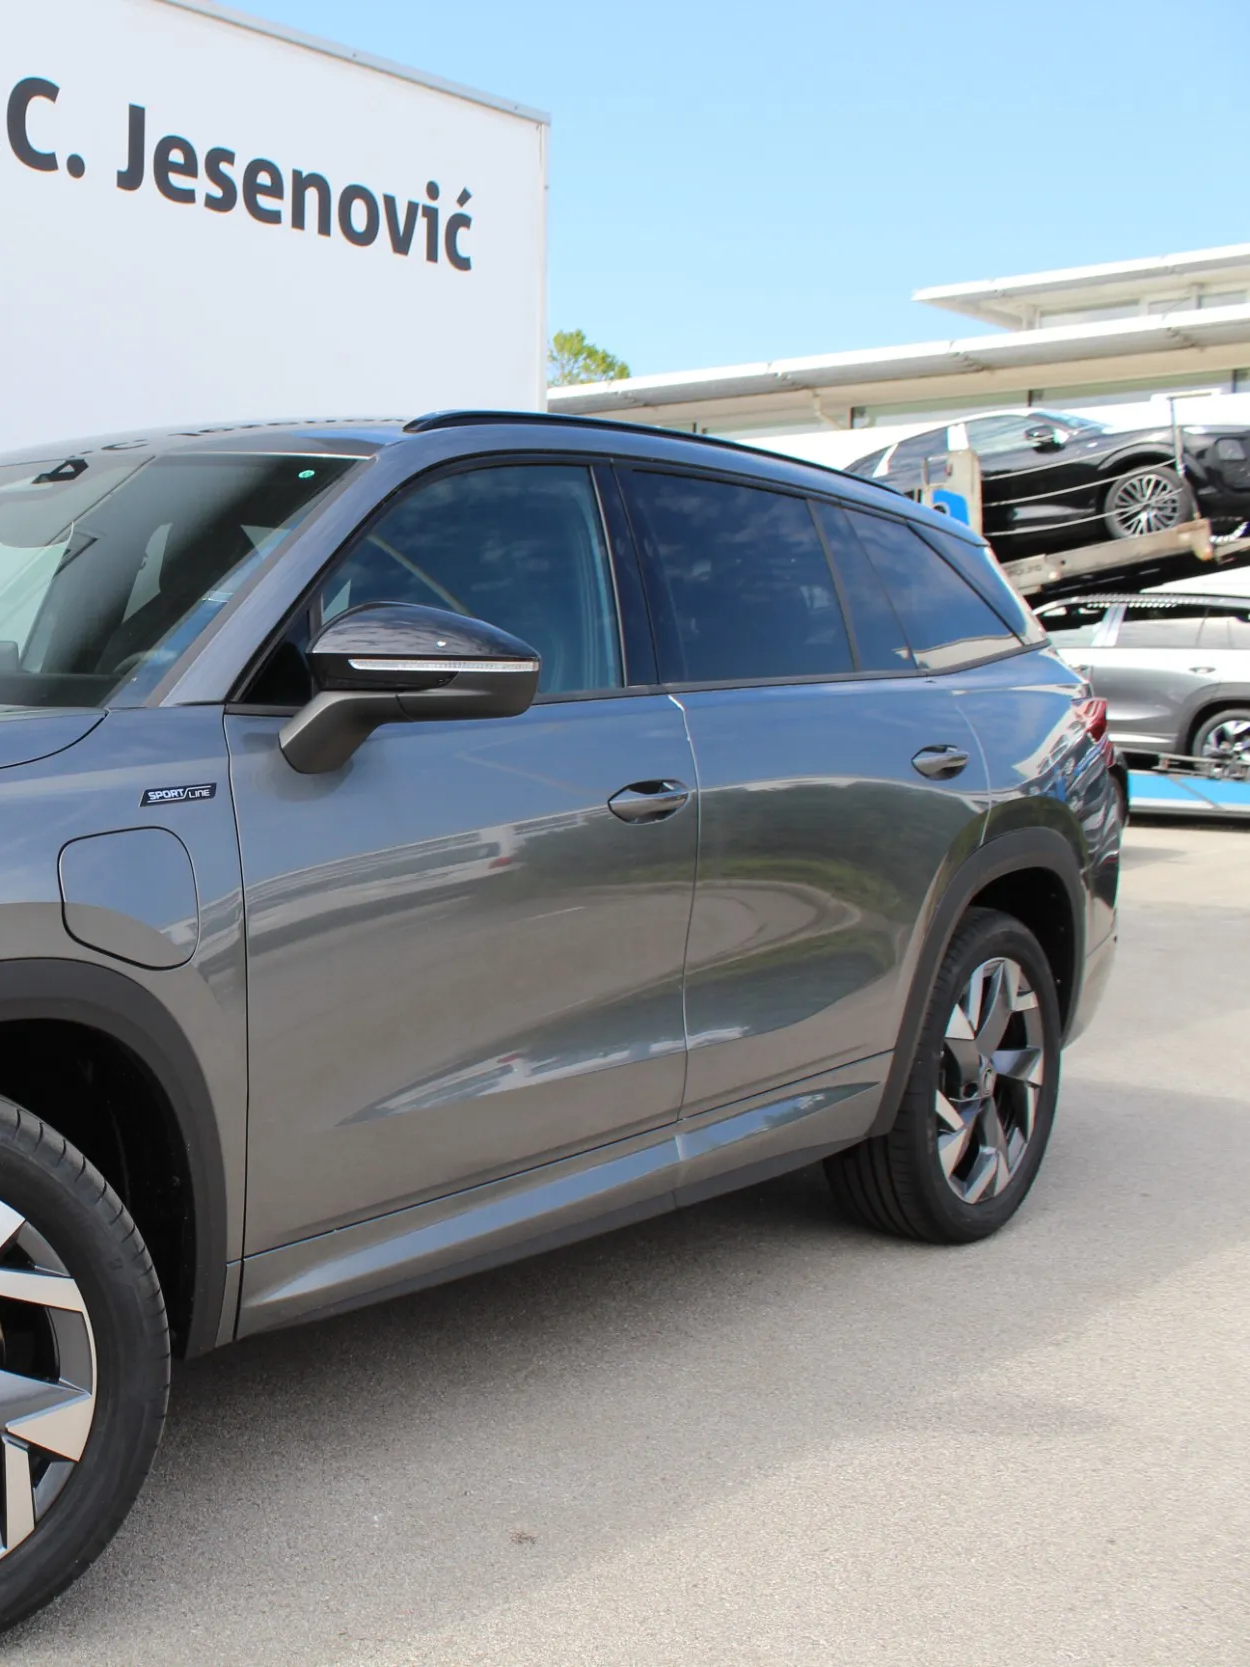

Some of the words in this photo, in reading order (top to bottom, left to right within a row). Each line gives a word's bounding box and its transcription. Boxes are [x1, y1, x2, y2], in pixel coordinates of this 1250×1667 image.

[116, 103, 472, 272] Jesenović
[148, 788, 184, 800] SPORT
[188, 789, 211, 798] LINE
